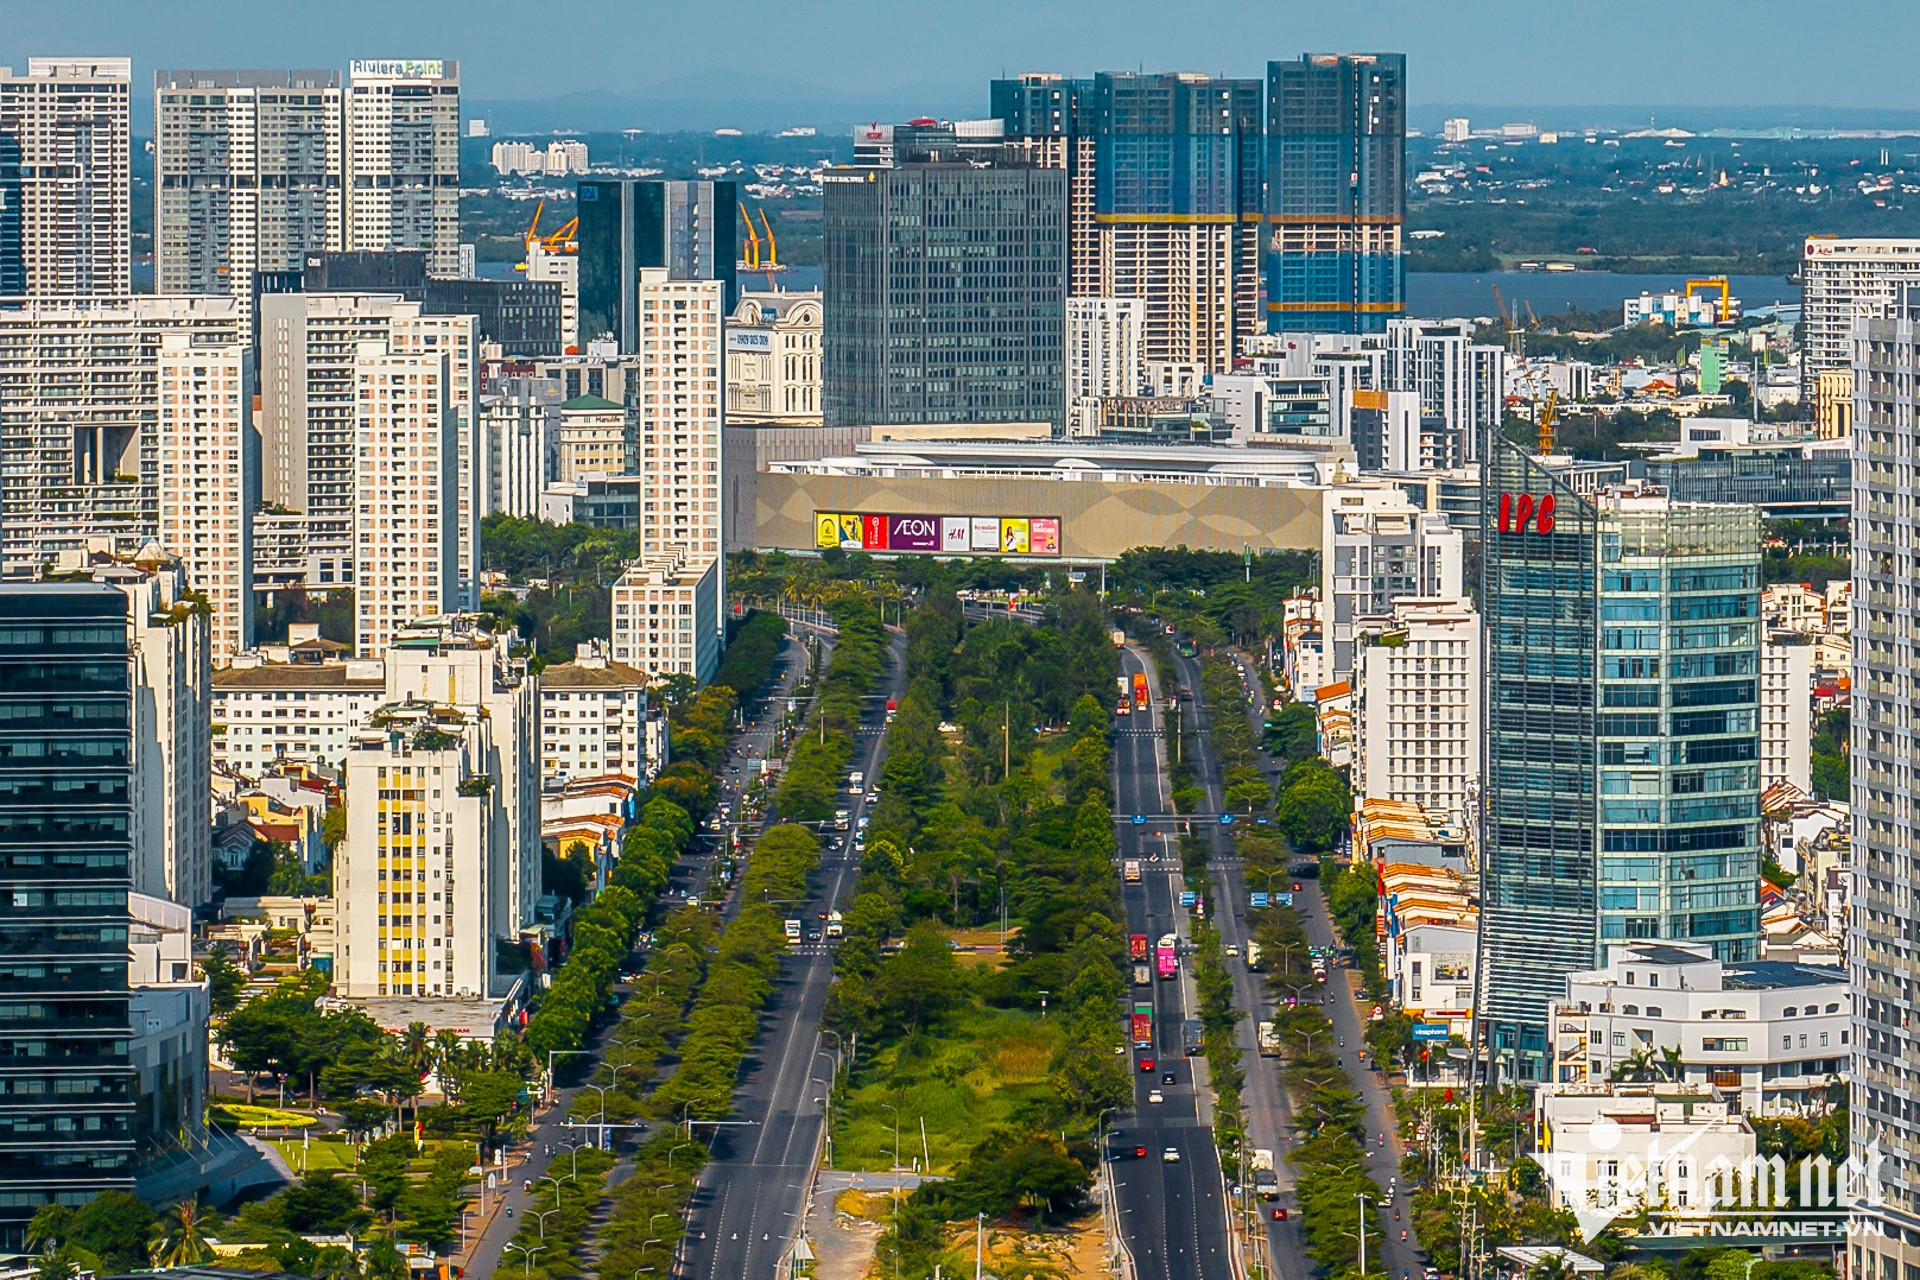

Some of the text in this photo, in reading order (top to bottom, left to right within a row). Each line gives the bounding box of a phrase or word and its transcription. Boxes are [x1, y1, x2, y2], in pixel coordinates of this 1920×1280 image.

[353, 60, 442, 75] Riviera Point
[1498, 492, 1556, 534] IPC
[1414, 1028, 1447, 1036] vinaphone
